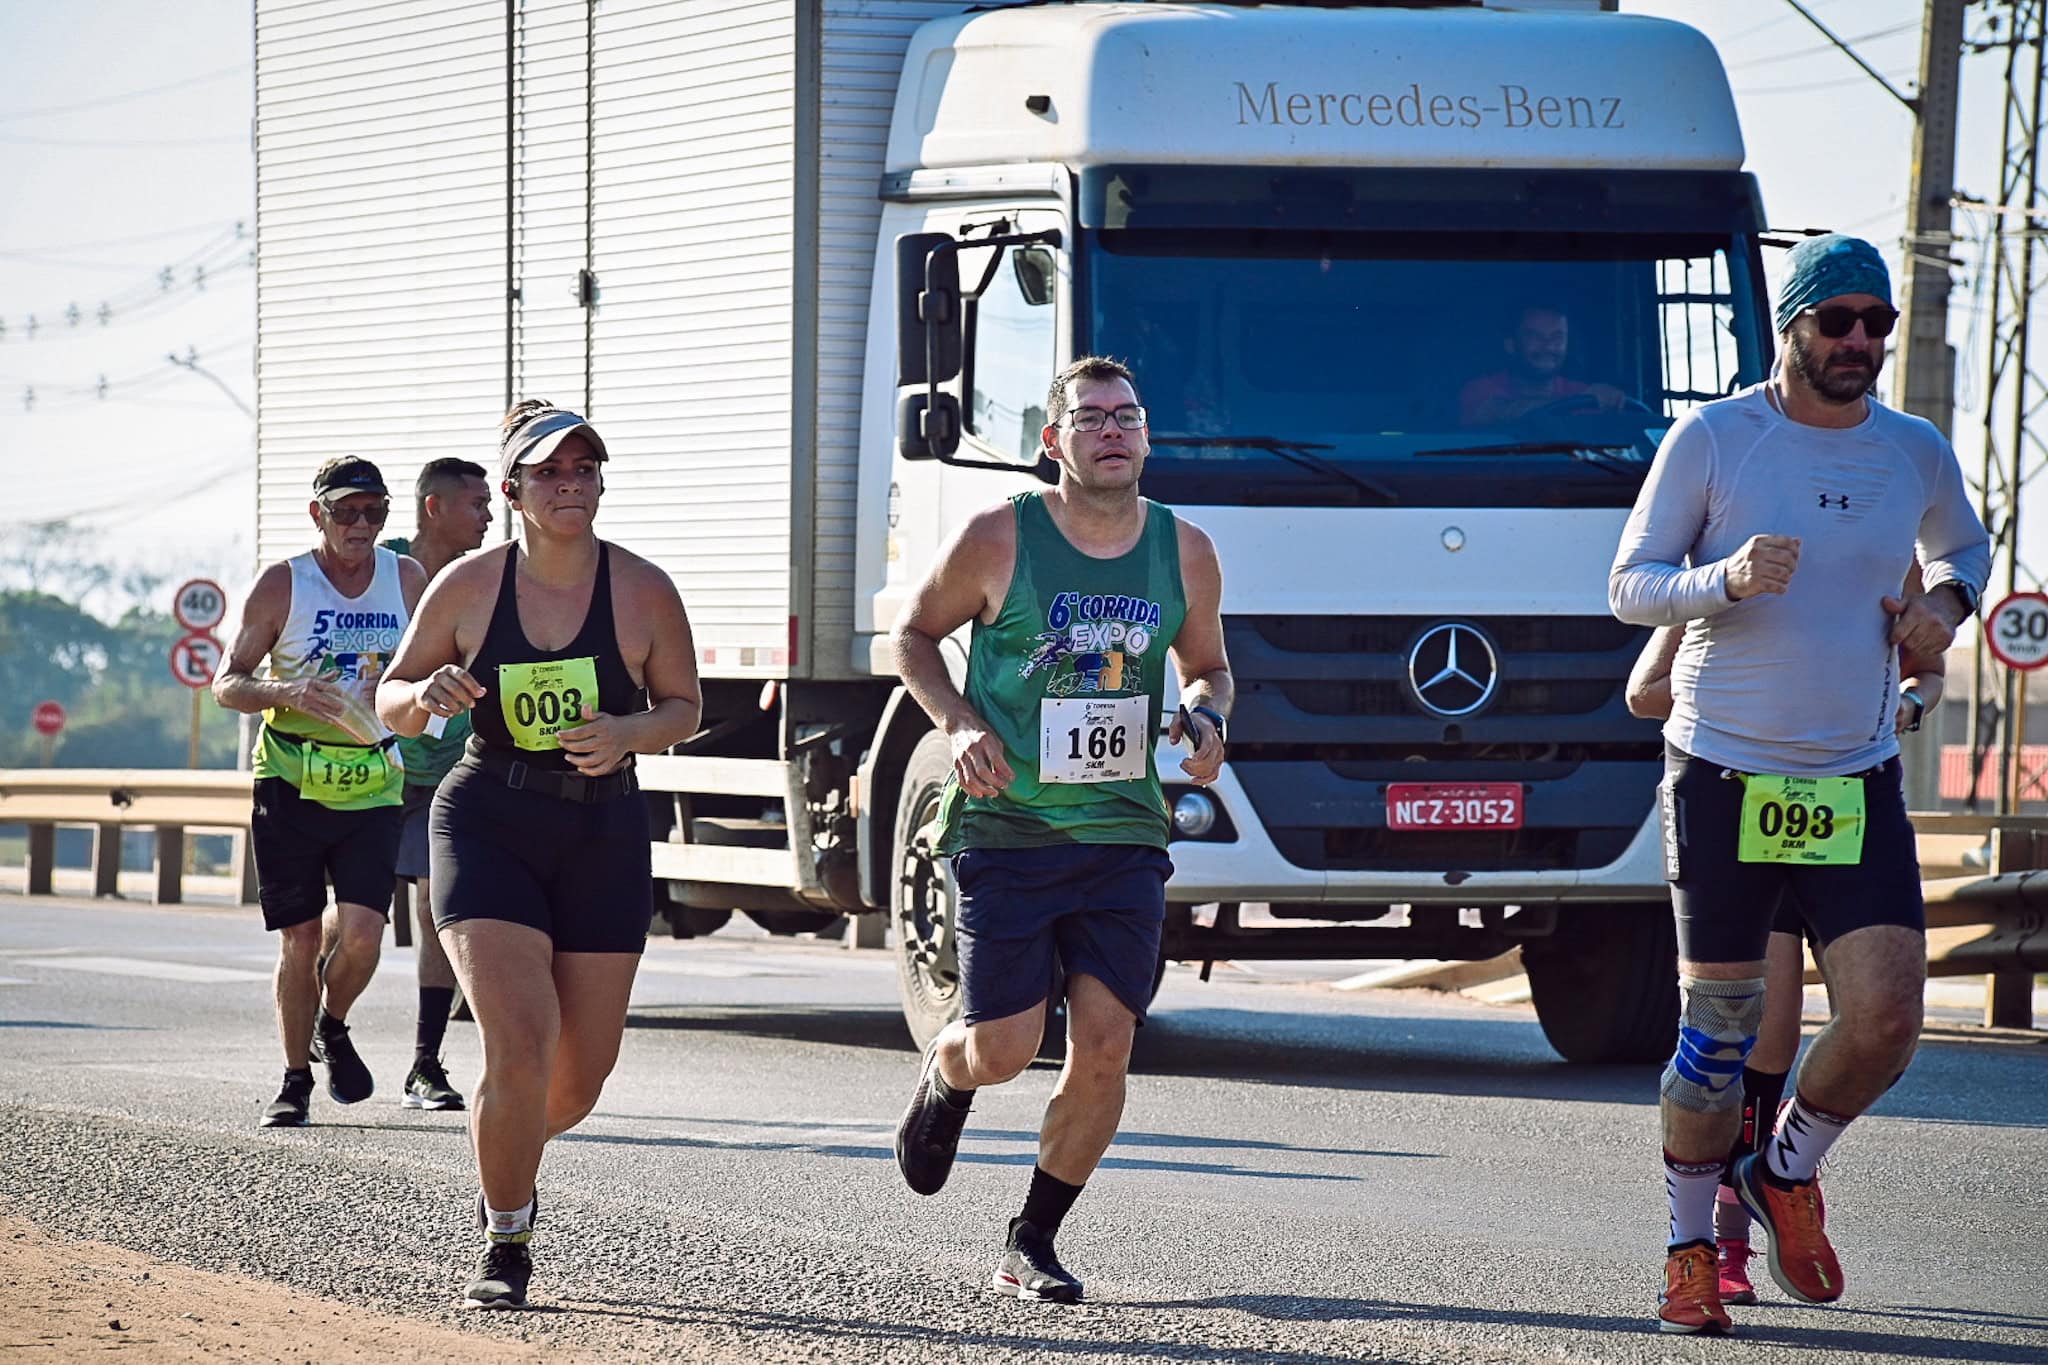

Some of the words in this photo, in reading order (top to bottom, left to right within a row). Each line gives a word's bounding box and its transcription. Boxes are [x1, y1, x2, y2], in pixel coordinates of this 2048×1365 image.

[1233, 81, 1625, 129] Mercedes-Benz
[183, 589, 219, 614] 40
[1079, 595, 1160, 628] CORRIDA
[336, 612, 398, 629] CORRIDA
[2002, 608, 2048, 641] 30
[330, 629, 397, 652] EXPO
[1069, 621, 1151, 657] EXPO
[515, 688, 582, 727] 003
[1068, 725, 1126, 760] 166
[322, 761, 370, 785] 129
[1759, 801, 1834, 839] 093
